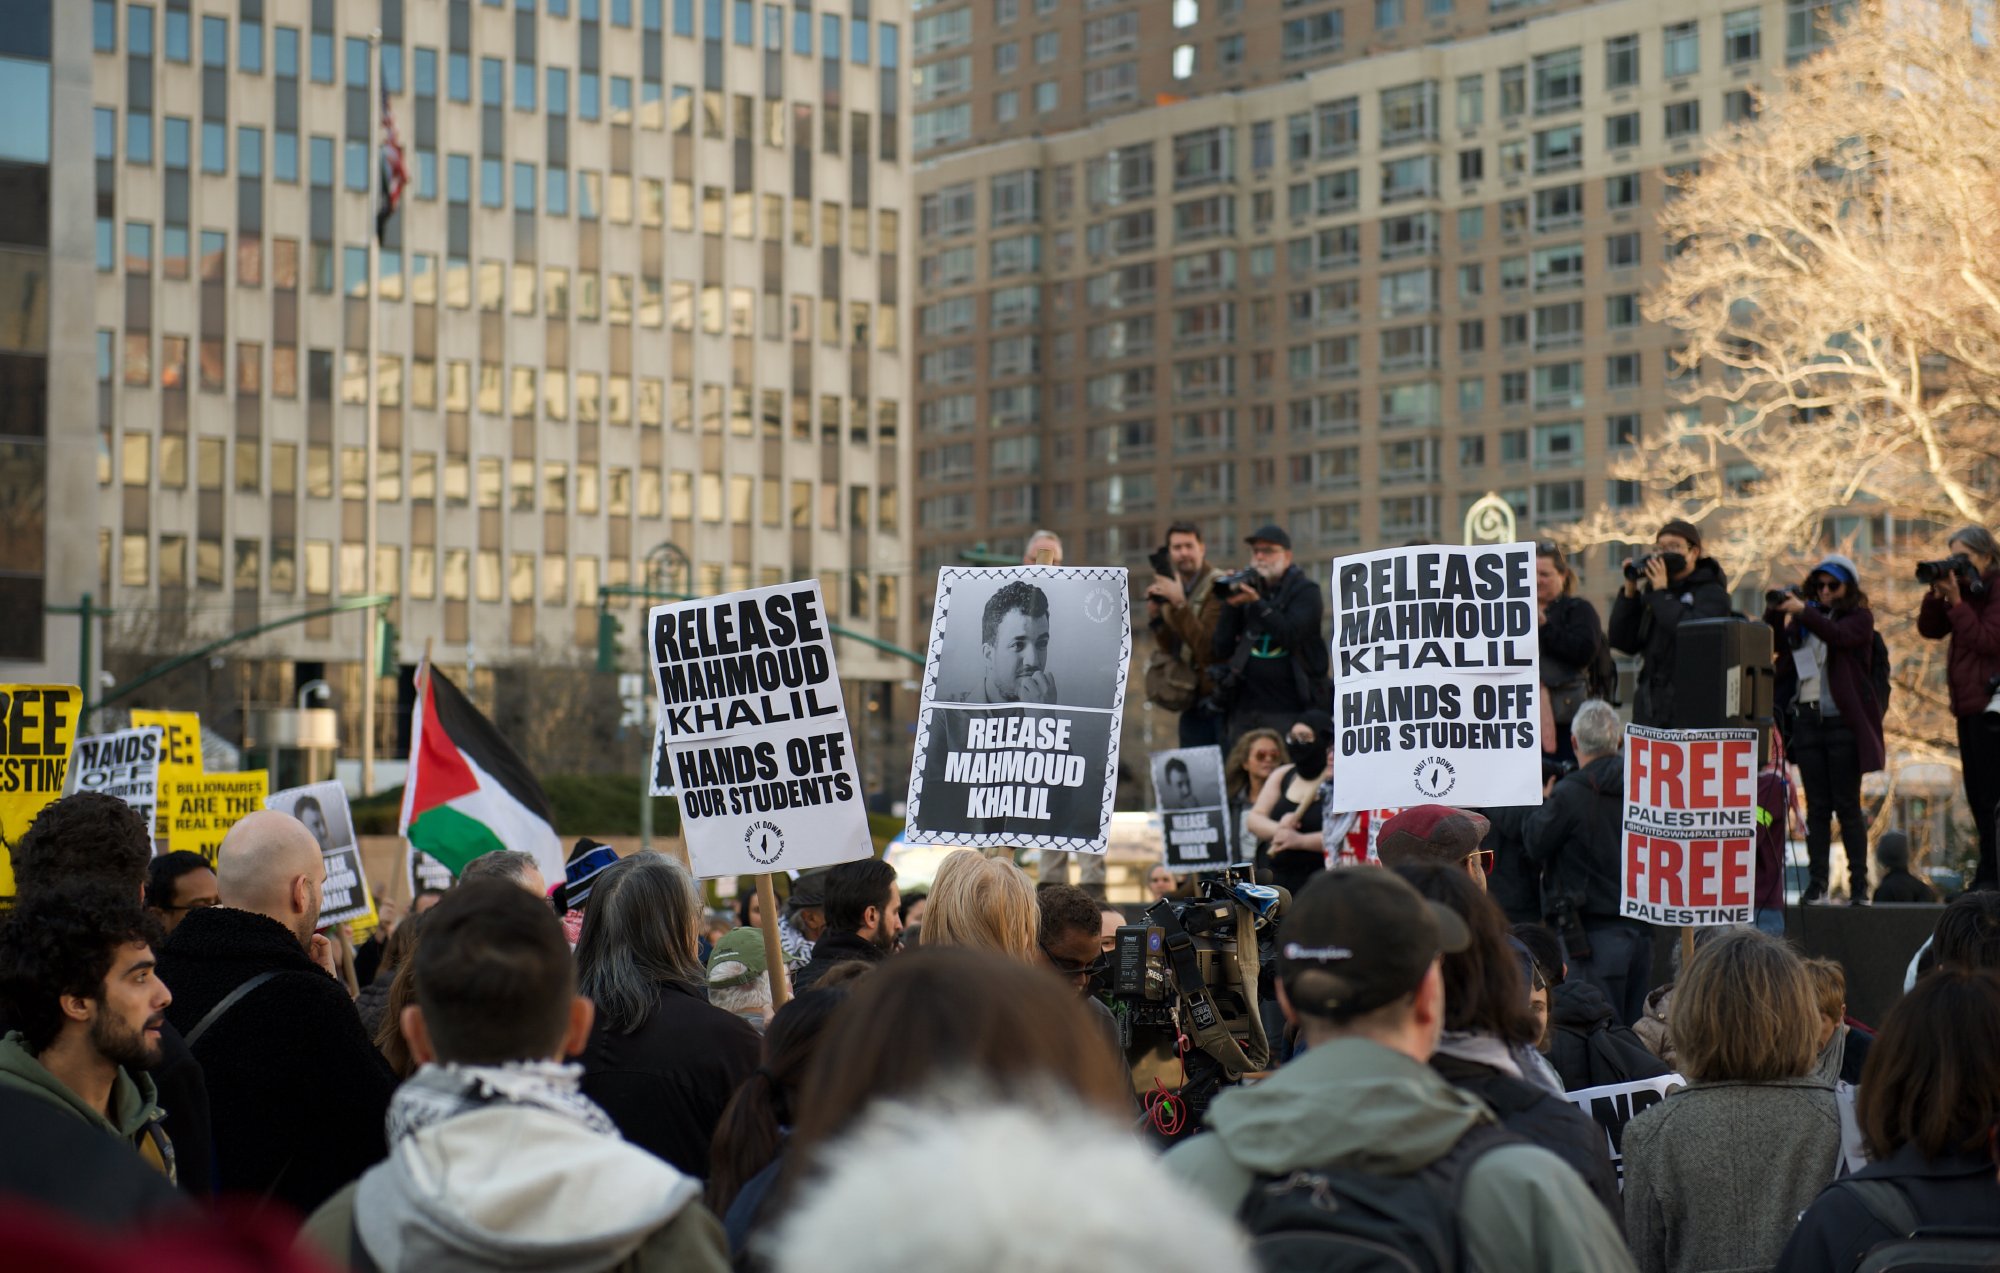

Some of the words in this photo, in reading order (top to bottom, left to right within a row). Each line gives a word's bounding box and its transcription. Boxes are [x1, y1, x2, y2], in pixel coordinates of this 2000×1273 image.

[1340, 551, 1531, 611] RELEASE
[655, 590, 823, 663] RELEASE
[1340, 601, 1531, 647] MAHMOUD
[659, 645, 829, 705] MAHMOUD
[1340, 640, 1533, 677] KHALIL
[667, 689, 838, 735] KHALIL
[1342, 684, 1461, 728] HANDS
[1473, 684, 1533, 720] OFF
[966, 716, 1072, 750] RELEASE
[1342, 725, 1391, 756] OUR
[1400, 721, 1534, 750] STUDENTS
[81, 734, 157, 770] HANDS
[677, 742, 778, 789] HANDS
[786, 732, 845, 776] OFF
[944, 751, 1085, 787] MAHMOUD
[1413, 760, 1427, 776] SHUT
[1427, 756, 1434, 764] IT
[1436, 756, 1456, 774] DOWN!
[0, 758, 67, 792] STINE
[81, 764, 153, 786] OFF
[177, 781, 262, 795] BILLIONAIRES
[1414, 779, 1424, 793] FOR
[1423, 777, 1456, 798] PALESTINE
[1629, 736, 1751, 810] FREE
[181, 798, 218, 814] ARE
[225, 797, 259, 813] THE
[684, 788, 727, 819] OUR
[730, 772, 853, 815] STUDENTS
[967, 786, 1051, 819] KHALIL
[176, 818, 208, 830] REAL
[744, 826, 755, 842] SHUT
[754, 821, 760, 829] IT
[762, 821, 784, 838] DOWN!
[1629, 805, 1751, 827] PALESTINE
[756, 840, 784, 864] PALESTINE
[1627, 833, 1750, 908] FREE
[1626, 901, 1749, 924] PALESTINE
